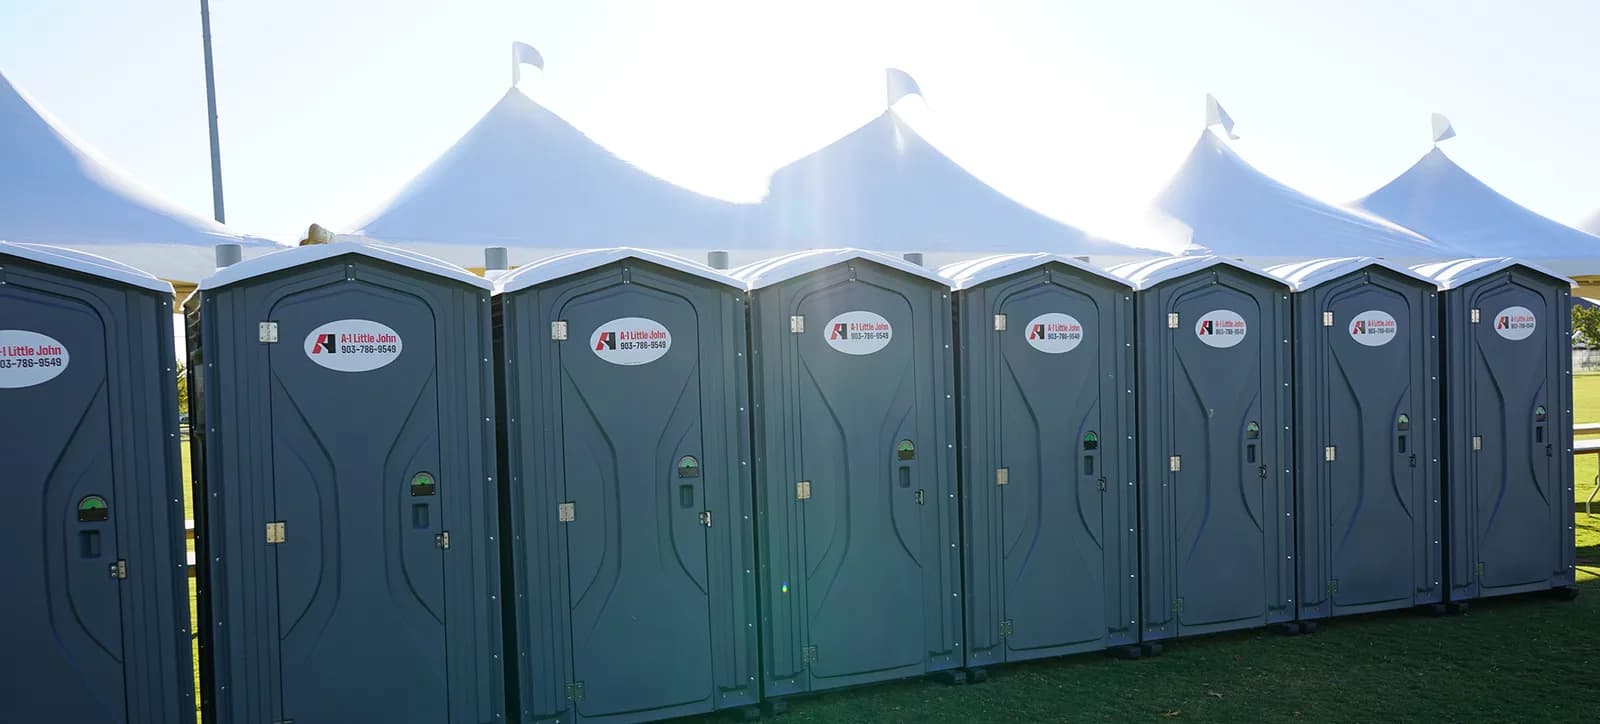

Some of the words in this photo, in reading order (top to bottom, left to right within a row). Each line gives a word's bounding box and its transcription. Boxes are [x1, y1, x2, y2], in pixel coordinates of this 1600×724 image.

[354, 334, 374, 343] Little
[376, 334, 396, 342] John
[631, 331, 648, 340] Little
[649, 330, 666, 339] John
[341, 345, 396, 353] 903-786-9549
[620, 341, 666, 350] 903-786-9549
[8, 345, 34, 357] Little
[36, 345, 61, 356] John
[0, 358, 61, 368] 03-786-9549
